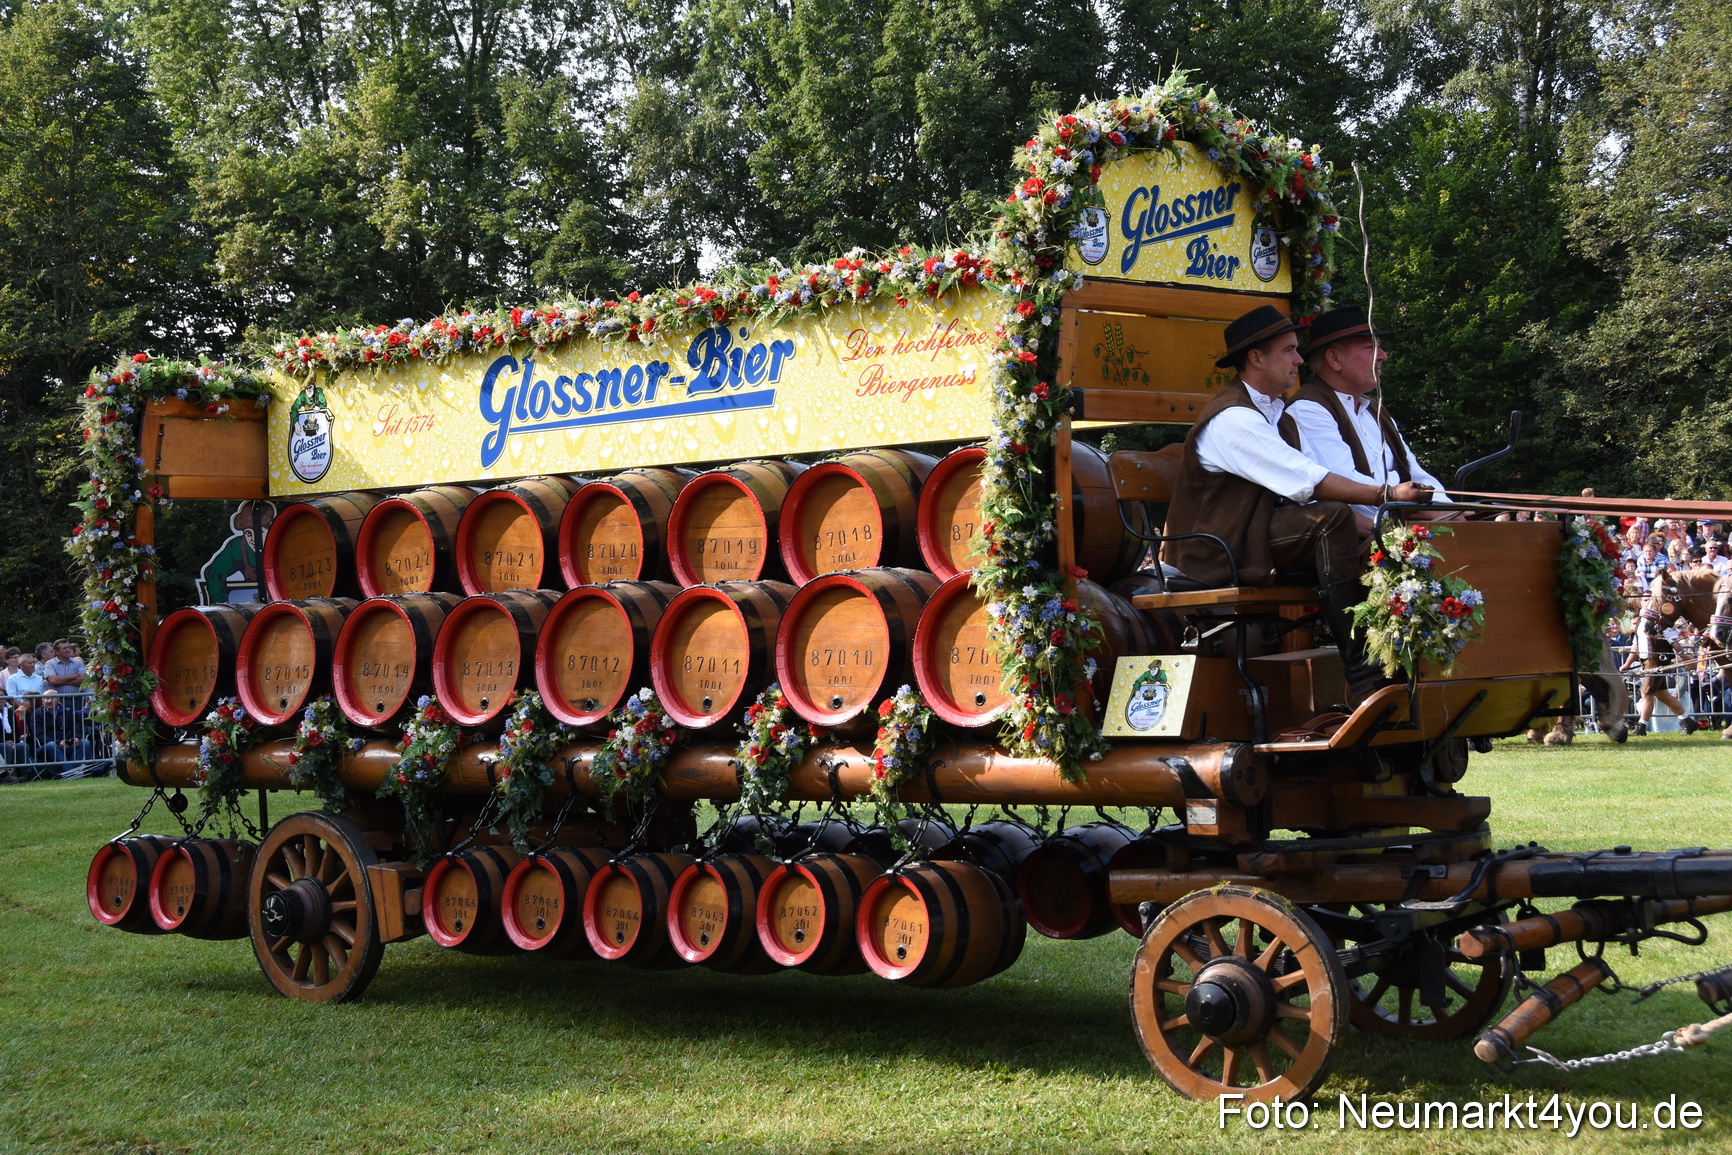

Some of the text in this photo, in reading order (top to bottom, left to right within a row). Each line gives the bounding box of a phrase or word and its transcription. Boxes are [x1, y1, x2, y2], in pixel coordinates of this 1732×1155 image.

[1121, 181, 1240, 276] Glossner
[1185, 235, 1240, 281] Bier
[842, 318, 989, 362] Der hochfeine
[856, 364, 977, 403] Biergenuss
[373, 404, 435, 437] Seit 1574
[293, 432, 327, 463] Glossner
[311, 447, 327, 461] Bier
[813, 524, 873, 551] 87018
[587, 543, 637, 560] 87020
[697, 538, 757, 556] 87019
[384, 551, 431, 577] 87022
[484, 551, 534, 568] 87021
[289, 557, 332, 581] 87023
[567, 654, 620, 675] 87012
[684, 655, 740, 675] 87011
[811, 649, 873, 667] 87010
[174, 665, 216, 684] 87016
[265, 664, 309, 681] 87015
[362, 662, 409, 679] 87014
[463, 661, 514, 678] 87013
[445, 898, 477, 909] 87066
[525, 895, 559, 910] 87065
[781, 905, 818, 918] 87062
[606, 907, 639, 922] 87064
[691, 907, 724, 923] 87063
[884, 917, 923, 934] 87061
